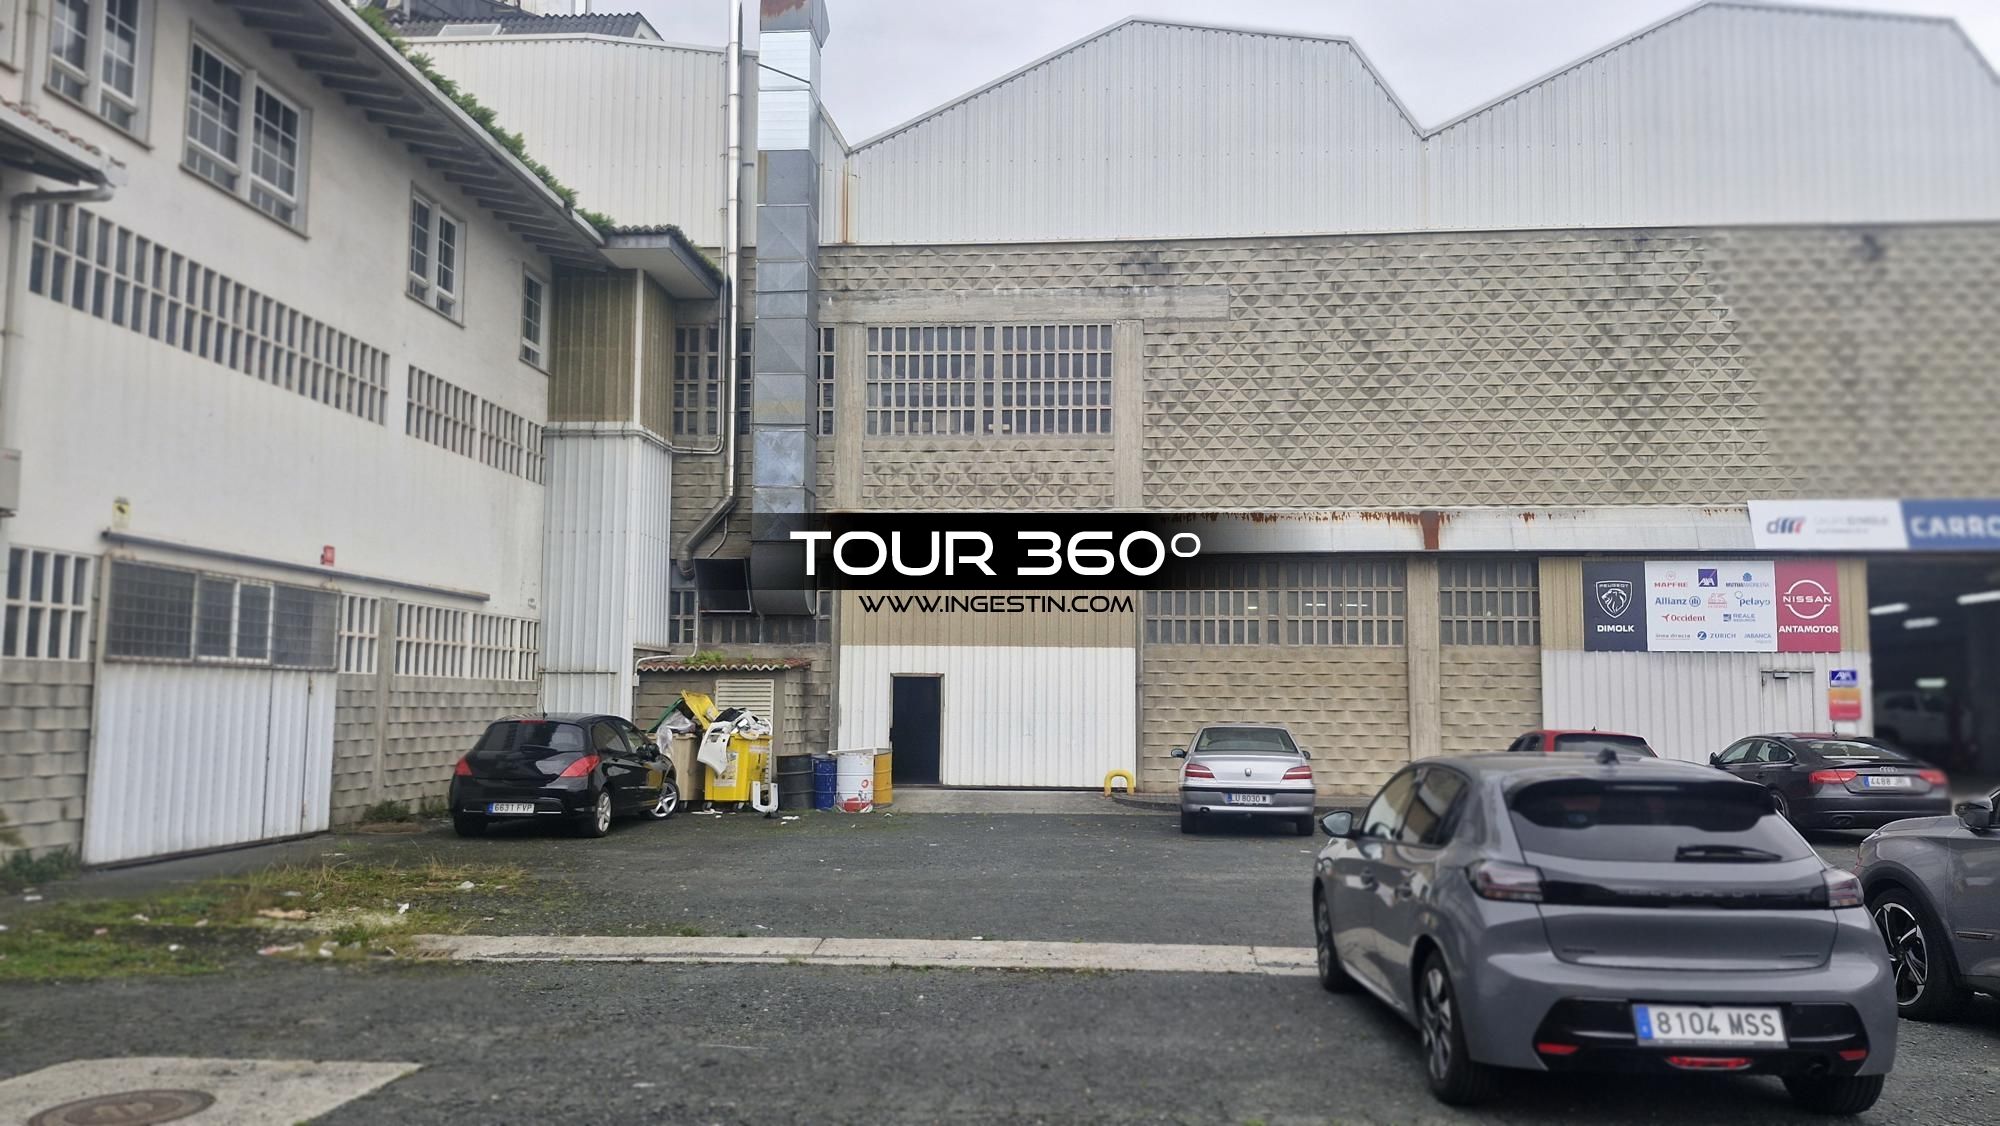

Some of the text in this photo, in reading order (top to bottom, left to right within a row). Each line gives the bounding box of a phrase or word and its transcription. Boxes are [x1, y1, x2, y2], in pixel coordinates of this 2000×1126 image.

[1655, 597, 1687, 605] Allianz
[1739, 597, 1771, 608] pelayo
[1782, 595, 1832, 603] NISSAN
[1670, 614, 1706, 622] Occident
[1597, 624, 1635, 633] DIMOLK
[1778, 625, 1839, 634] ANTAMOTOR
[1833, 671, 1853, 680] AXA
[1656, 1011, 1777, 1037] 8104 MSS
